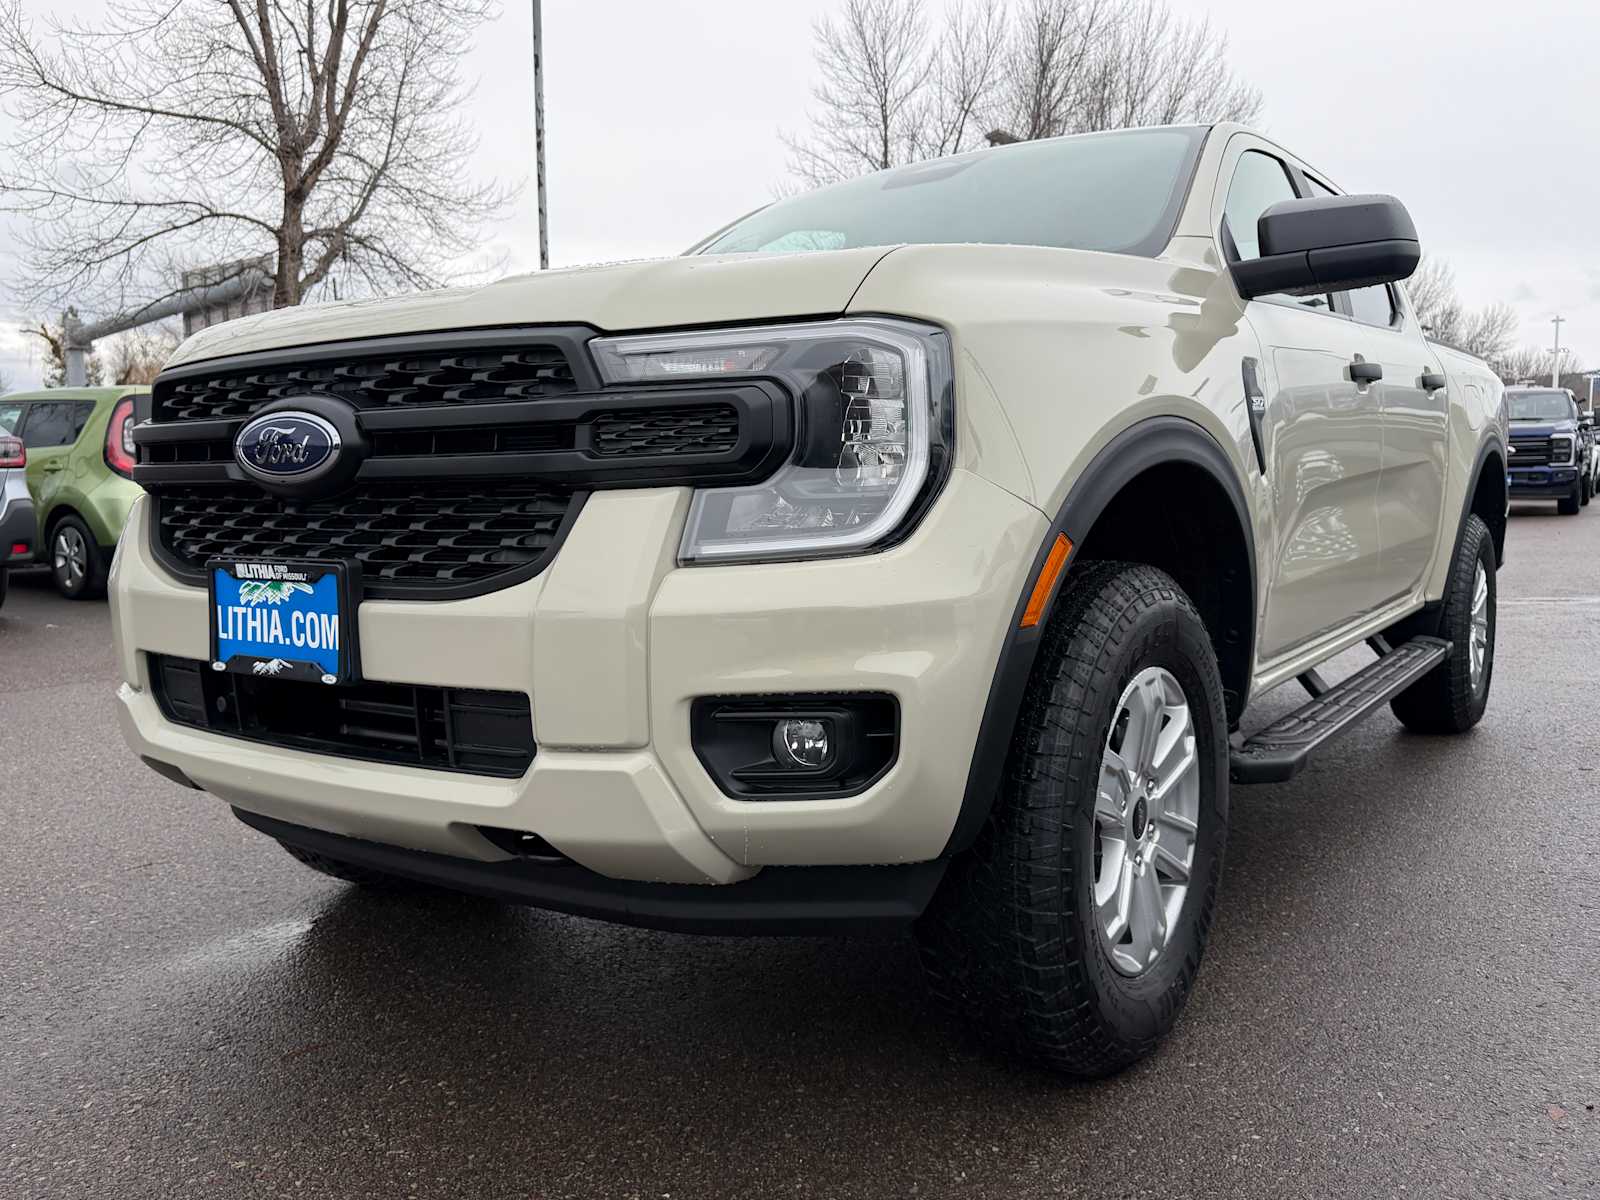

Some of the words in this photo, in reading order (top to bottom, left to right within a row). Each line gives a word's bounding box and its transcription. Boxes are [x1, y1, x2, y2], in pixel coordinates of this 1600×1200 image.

[255, 426, 310, 464] Ford
[244, 563, 276, 579] LITHIA
[274, 565, 288, 573] FORD
[217, 604, 339, 650] LITHIA.COM
